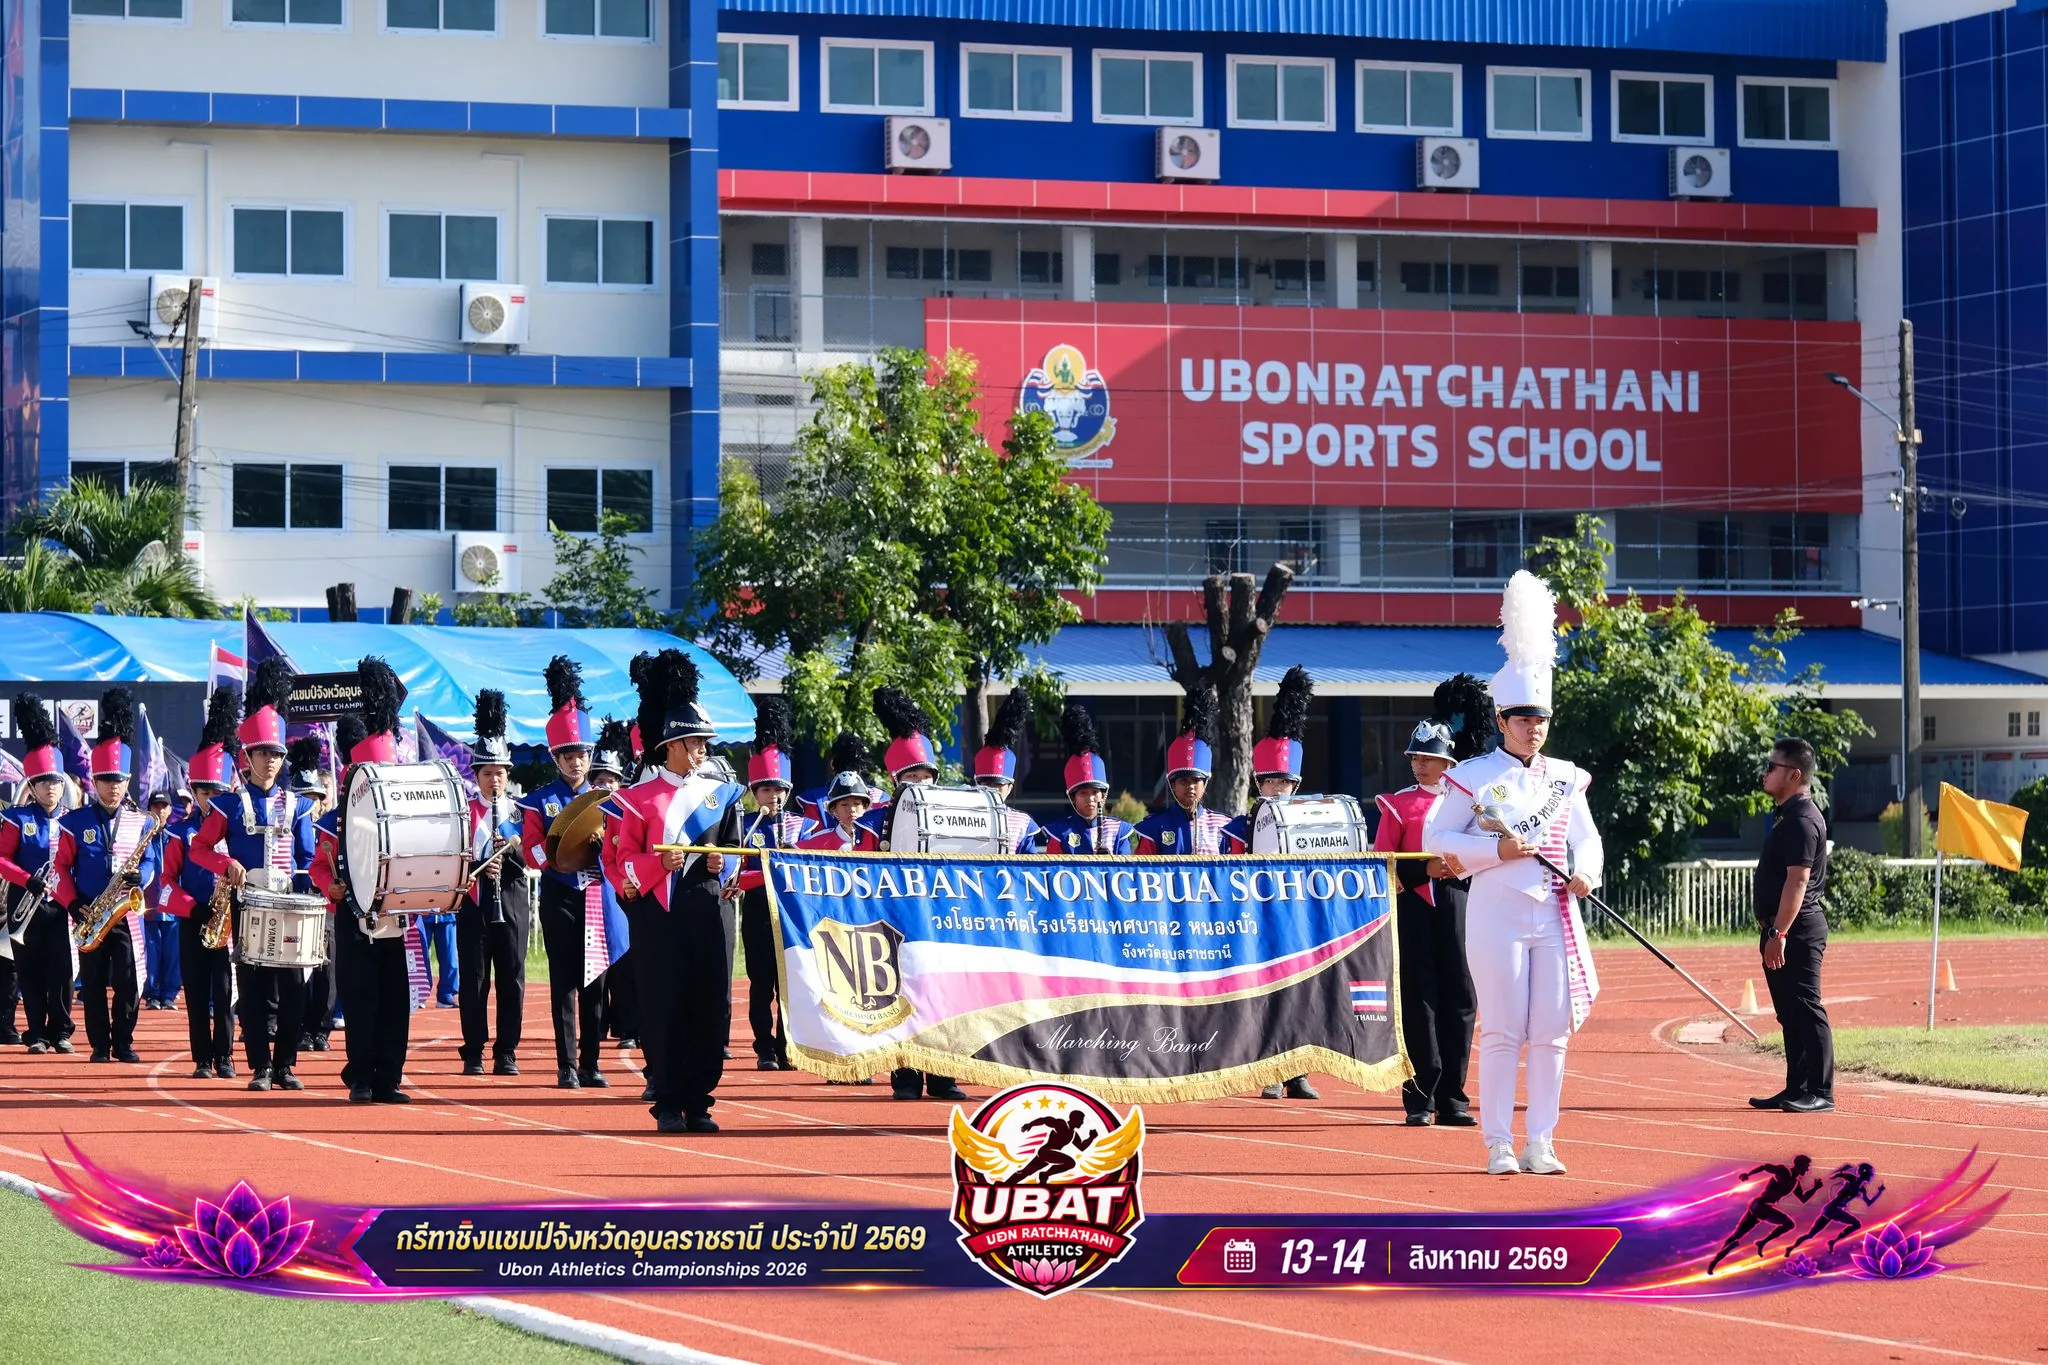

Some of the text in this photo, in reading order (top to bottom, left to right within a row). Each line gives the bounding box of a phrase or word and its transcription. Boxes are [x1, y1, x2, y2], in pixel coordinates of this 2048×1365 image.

[1181, 358, 1700, 412] UBONRATCHATHANI
[1242, 421, 1661, 472] SPORTS SCHOOL
[290, 702, 363, 713] ATHLETICS CHAMPI
[403, 790, 446, 801] YAMAHA
[946, 816, 987, 828] YAMAHA
[1529, 814, 1541, 828] 2
[1309, 835, 1349, 848] YAMAHA
[775, 861, 1387, 903] TEDSABAN 2 NONGBUA SCHOOL
[1188, 912, 1259, 936] หนองบัว
[267, 927, 278, 957] YAMAHA
[1121, 943, 1232, 964] จังหวัดอุบลราชธานี
[817, 930, 898, 1006] NB
[878, 1007, 901, 1020] BAND
[1355, 1013, 1388, 1023] THAILAND
[1036, 1024, 1218, 1061] Marching Band
